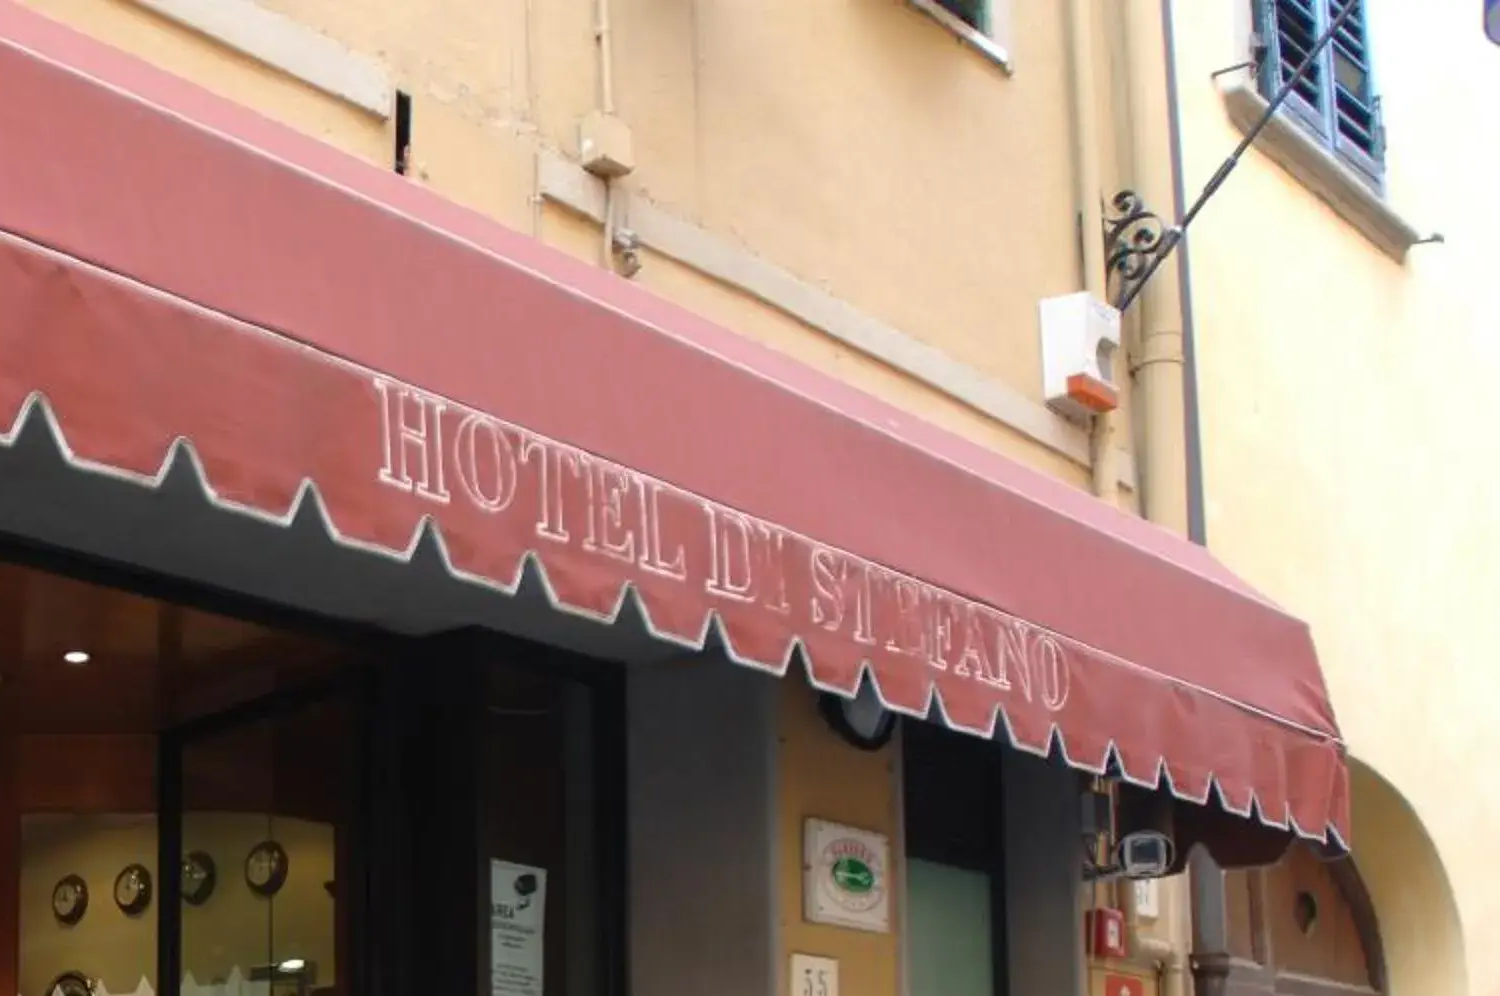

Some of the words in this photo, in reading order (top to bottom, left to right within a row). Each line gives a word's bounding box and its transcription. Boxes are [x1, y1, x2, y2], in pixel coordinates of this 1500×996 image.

[373, 376, 687, 581] HOTEL
[703, 502, 791, 615] DI
[811, 545, 1073, 711] STEFANO
